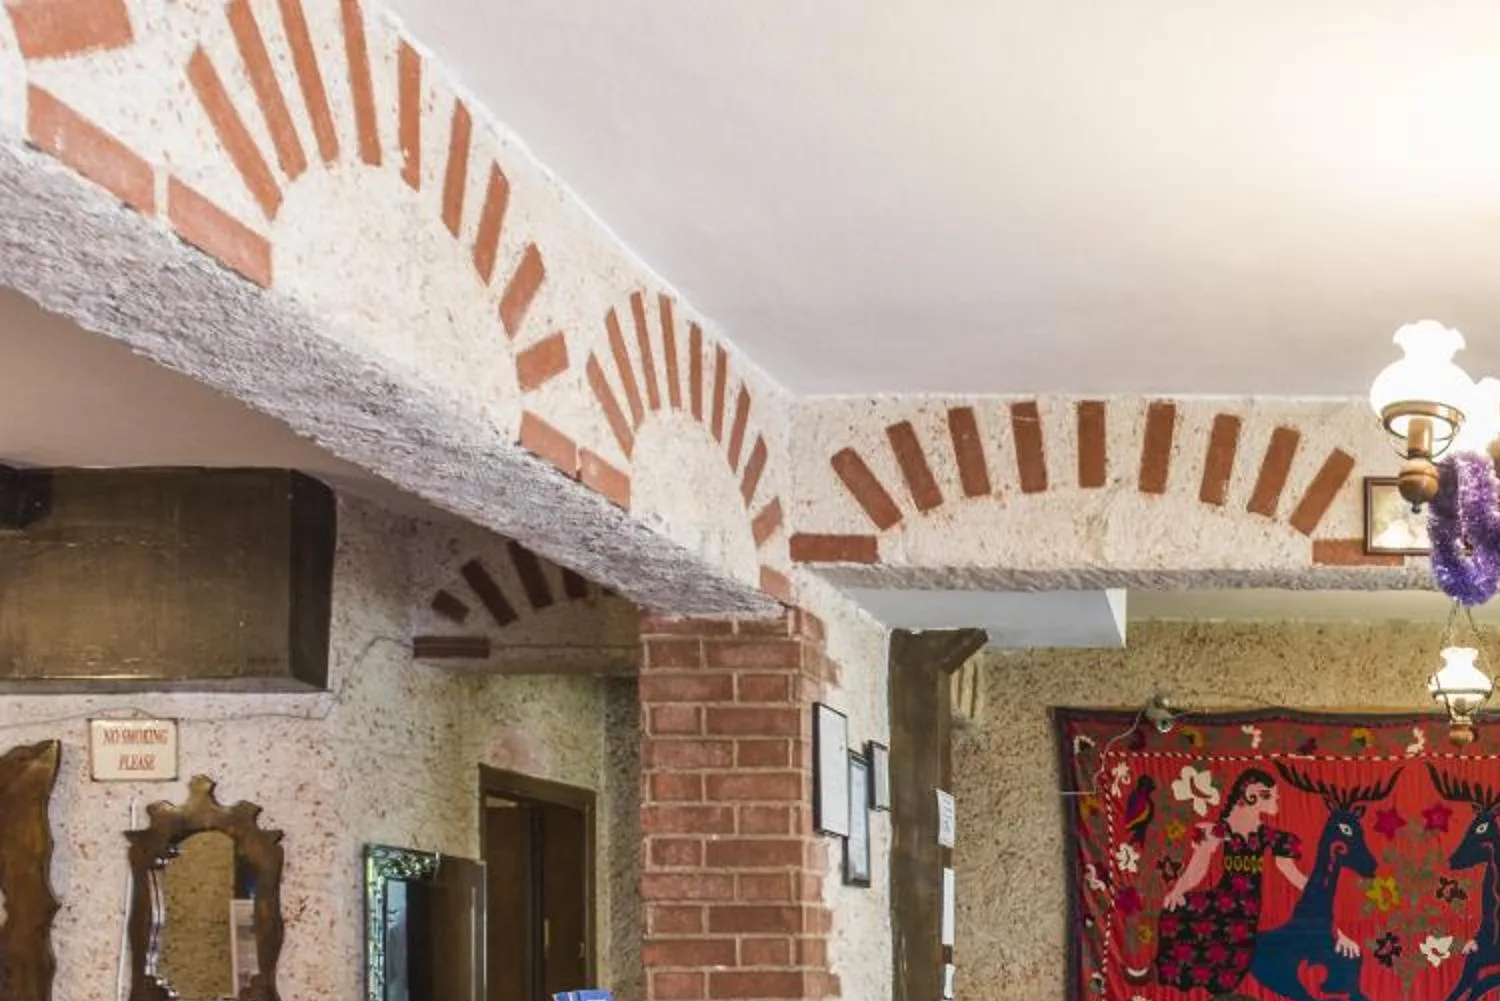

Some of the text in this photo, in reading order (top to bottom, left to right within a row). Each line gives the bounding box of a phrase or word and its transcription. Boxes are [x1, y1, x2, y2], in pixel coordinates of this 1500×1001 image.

[103, 728, 168, 745] NO SMOKING
[118, 753, 156, 770] PLEASE
